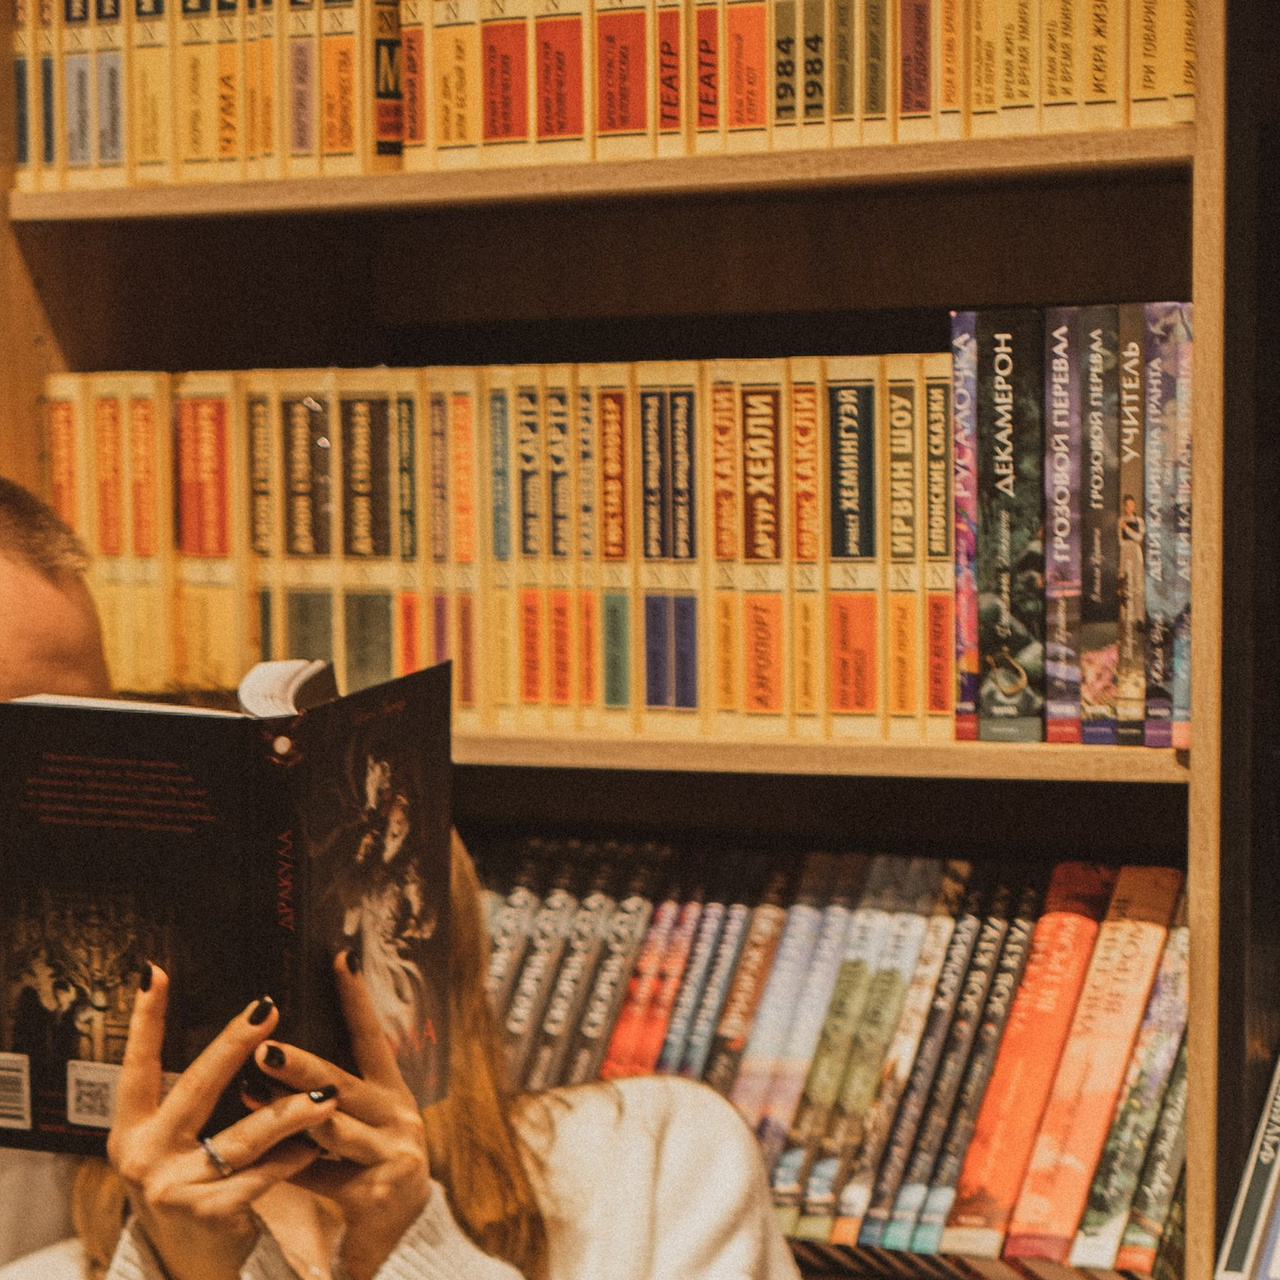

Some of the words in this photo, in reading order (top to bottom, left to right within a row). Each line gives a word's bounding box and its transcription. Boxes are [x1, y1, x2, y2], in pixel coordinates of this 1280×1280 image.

[776, 35, 795, 117] 1984
[804, 34, 823, 116] 1984
[1004, 24, 1015, 56] ЖИТЬ
[1019, 46, 1030, 87] ВРЕМЯ
[1047, 20, 1058, 54] ЖИТЬ
[1047, 57, 1058, 97] ВРЕМЯ
[1061, 42, 1073, 84] ВРЕМЯ
[1093, 45, 1108, 95] ИСКРА
[1143, 65, 1157, 91] ТРИ
[1184, 60, 1197, 86] ТРИ
[219, 74, 237, 153] ЧУМА
[660, 40, 680, 123] ТЕАТР
[698, 38, 718, 122] ТЕАТР
[1004, 59, 1015, 100] ВРЕМЯ
[1051, 326, 1070, 428] ПЕРЕВАЛ
[1089, 328, 1104, 408] ПЕРЕВАЛ
[1121, 341, 1141, 463] УЧИТЕЛЬ
[1147, 357, 1163, 424] ГРАНТА
[713, 391, 735, 492] ХАКСЛИ
[744, 394, 775, 496] ХЕЙЛИ
[794, 391, 817, 494] ХАКСЛИ
[836, 388, 860, 511] ХЕМИНГУЭЙ
[890, 394, 913, 455] ШОУ
[929, 387, 945, 457] СКАЗКИ
[953, 332, 972, 498] РУСАЛОЧКА
[993, 332, 1016, 498] ДЕКАМЕРОН
[1051, 434, 1072, 563] ГРОЗОВОЙ
[1089, 411, 1104, 510] ГРОЗОВОЙ
[1147, 428, 1163, 529] КАПИТАНА
[754, 498, 776, 558] АРТУР
[890, 461, 913, 554] ИРВИН
[929, 460, 946, 553] ЯПОНСКИЕ
[1147, 533, 1163, 582] ДЕТИ
[751, 603, 772, 707] АЭРОПОРТ
[276, 829, 295, 930] ДРАКУЛА
